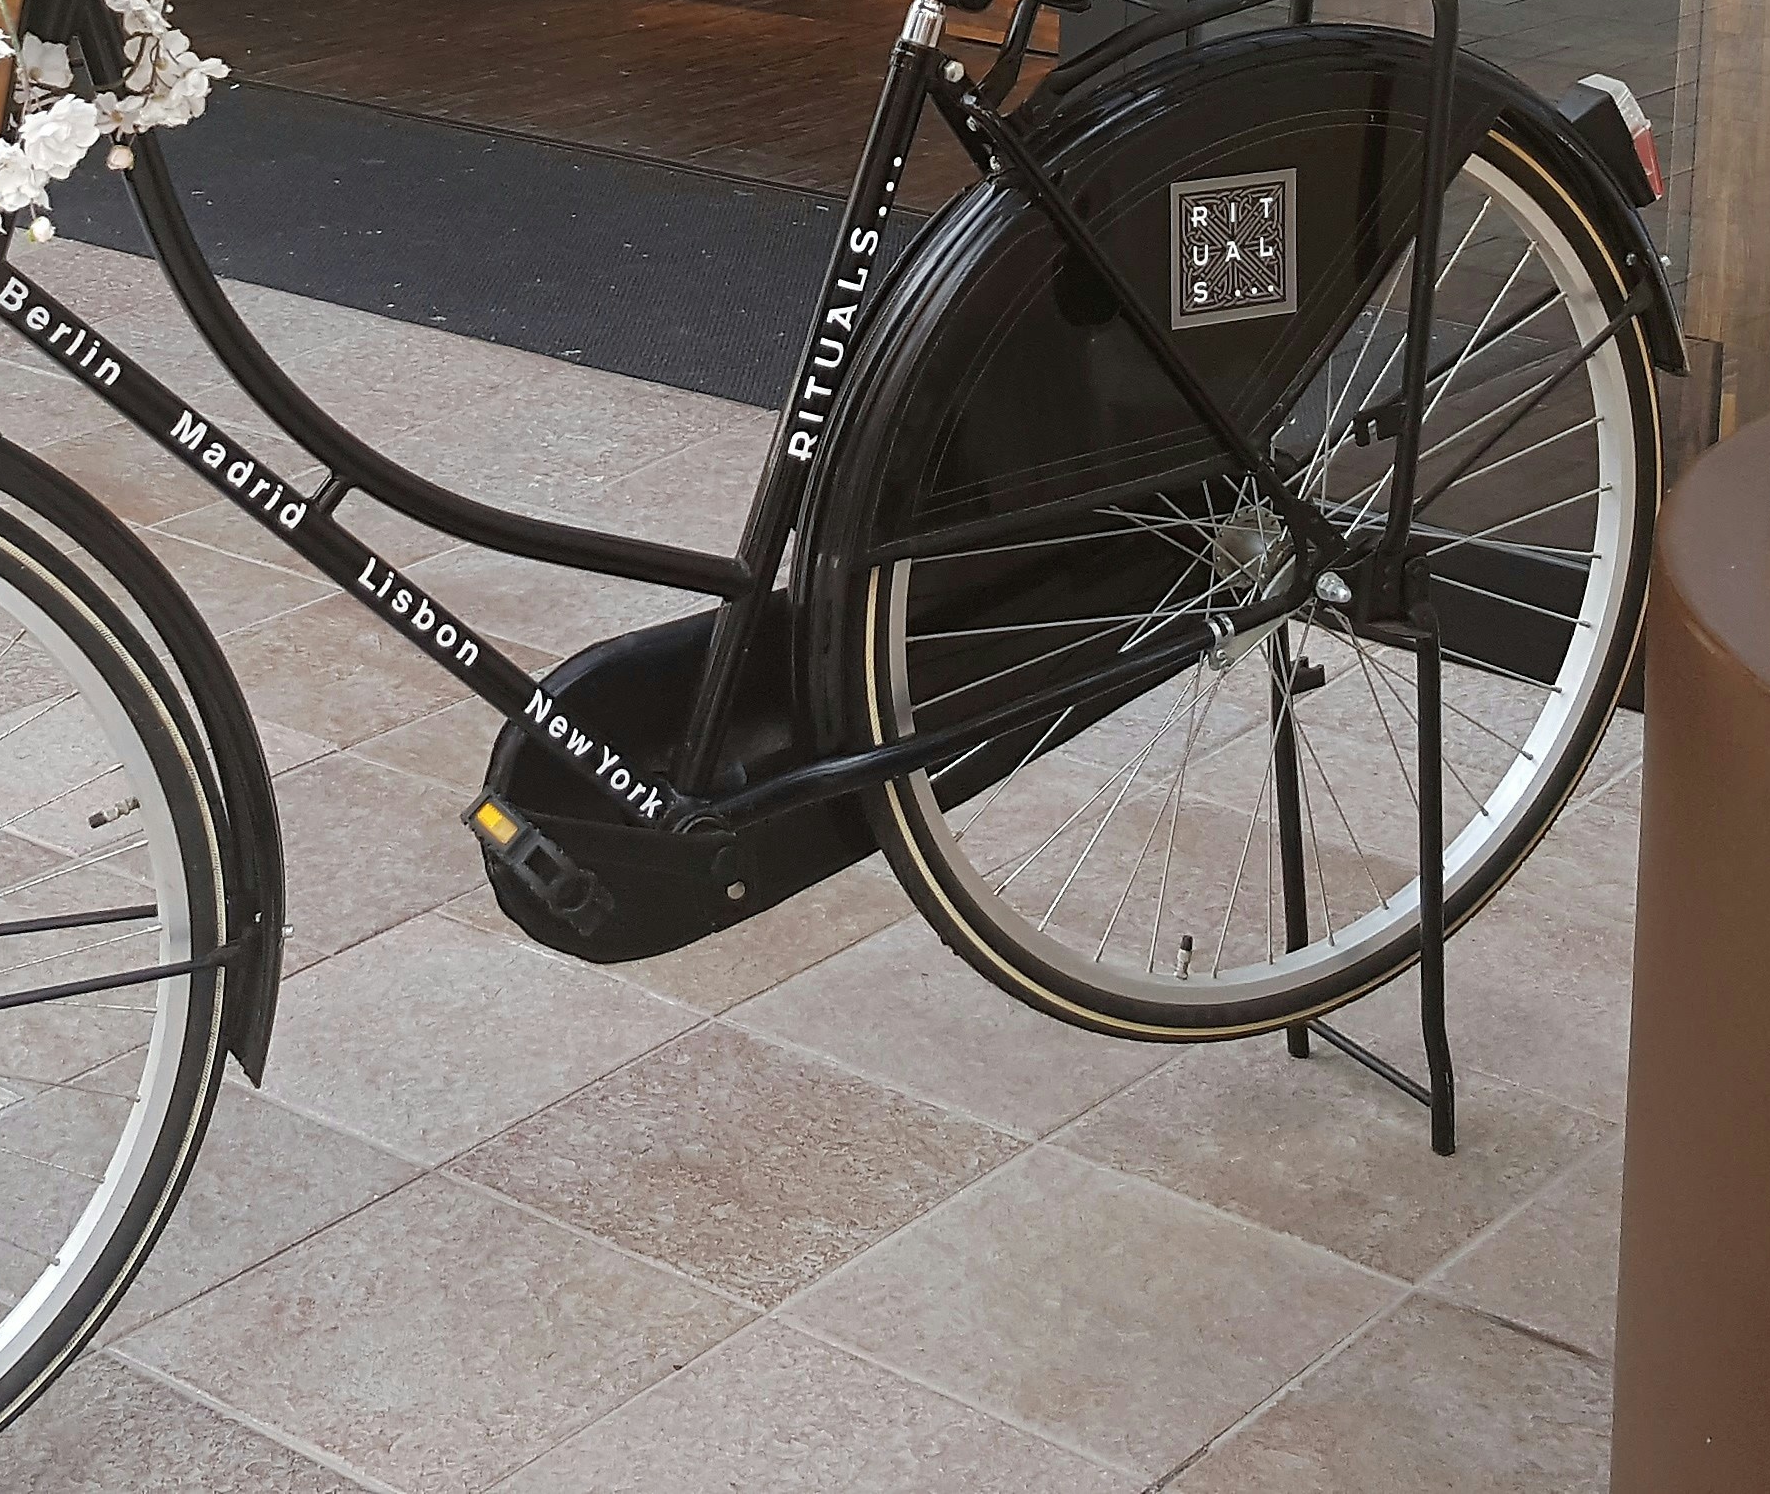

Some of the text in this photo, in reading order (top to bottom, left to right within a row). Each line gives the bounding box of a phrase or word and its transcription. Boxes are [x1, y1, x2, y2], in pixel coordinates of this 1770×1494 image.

[1191, 197, 1273, 227] RIT
[1192, 236, 1273, 266] UAL
[170, 410, 307, 529] Madrid
[358, 557, 479, 667] Lisbon
[525, 689, 593, 757] New
[596, 746, 663, 819] York
